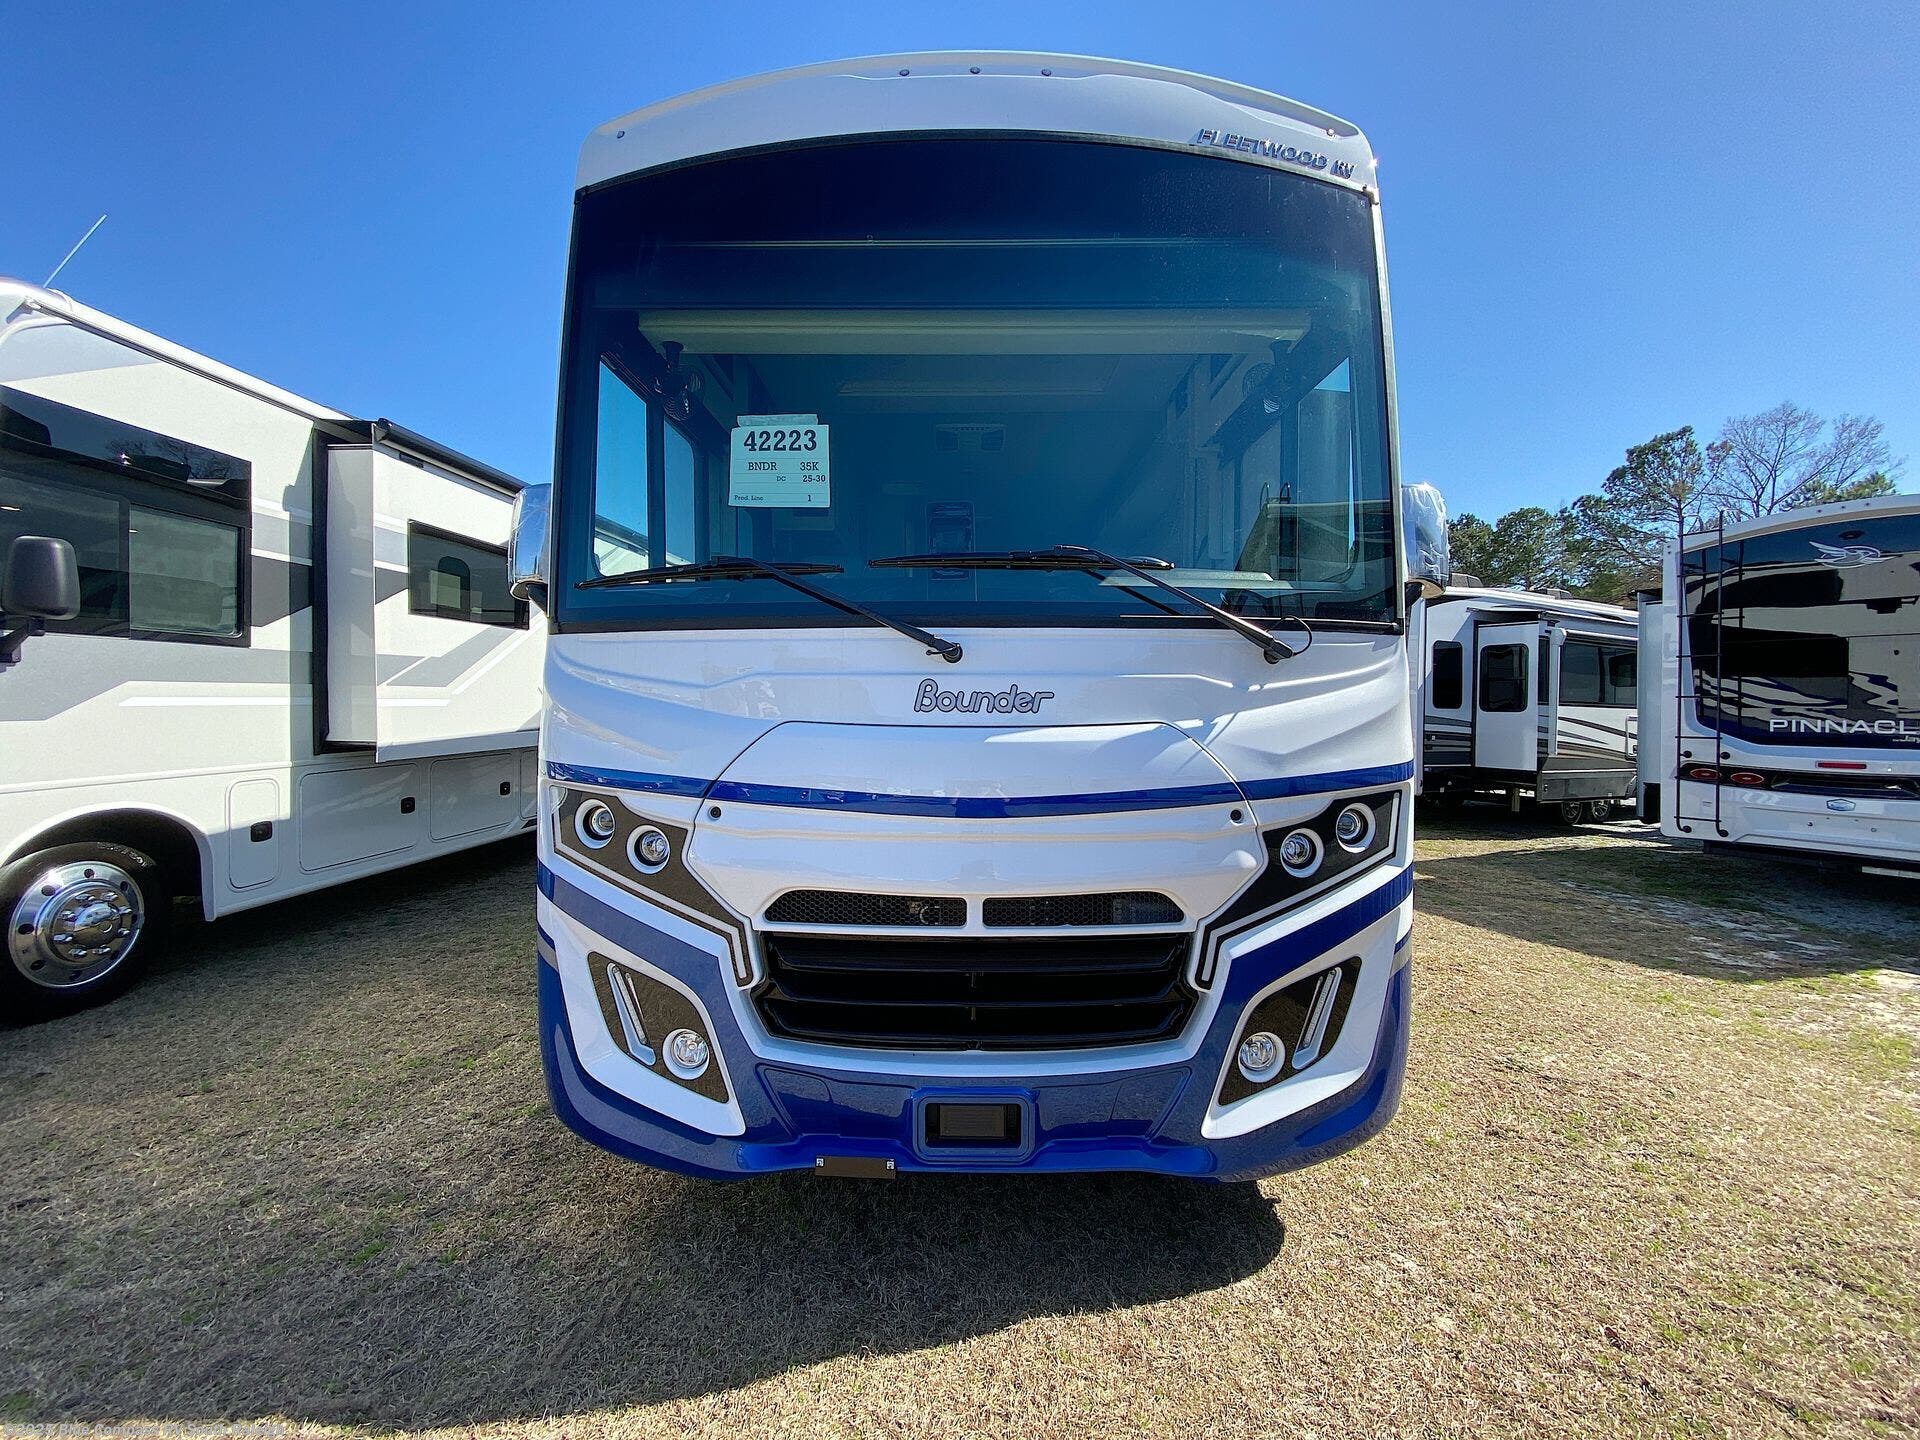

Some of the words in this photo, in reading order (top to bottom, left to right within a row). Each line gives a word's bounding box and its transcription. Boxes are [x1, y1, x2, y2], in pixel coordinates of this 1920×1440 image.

[1197, 128, 1328, 170] FLEETWOOD
[1330, 159, 1356, 180] RV
[743, 429, 817, 452] 42223
[748, 461, 777, 471] BNDR
[799, 461, 819, 471] 35K
[802, 474, 826, 483] 25-30
[807, 494, 812, 502] 1
[914, 678, 1055, 714] Bounder
